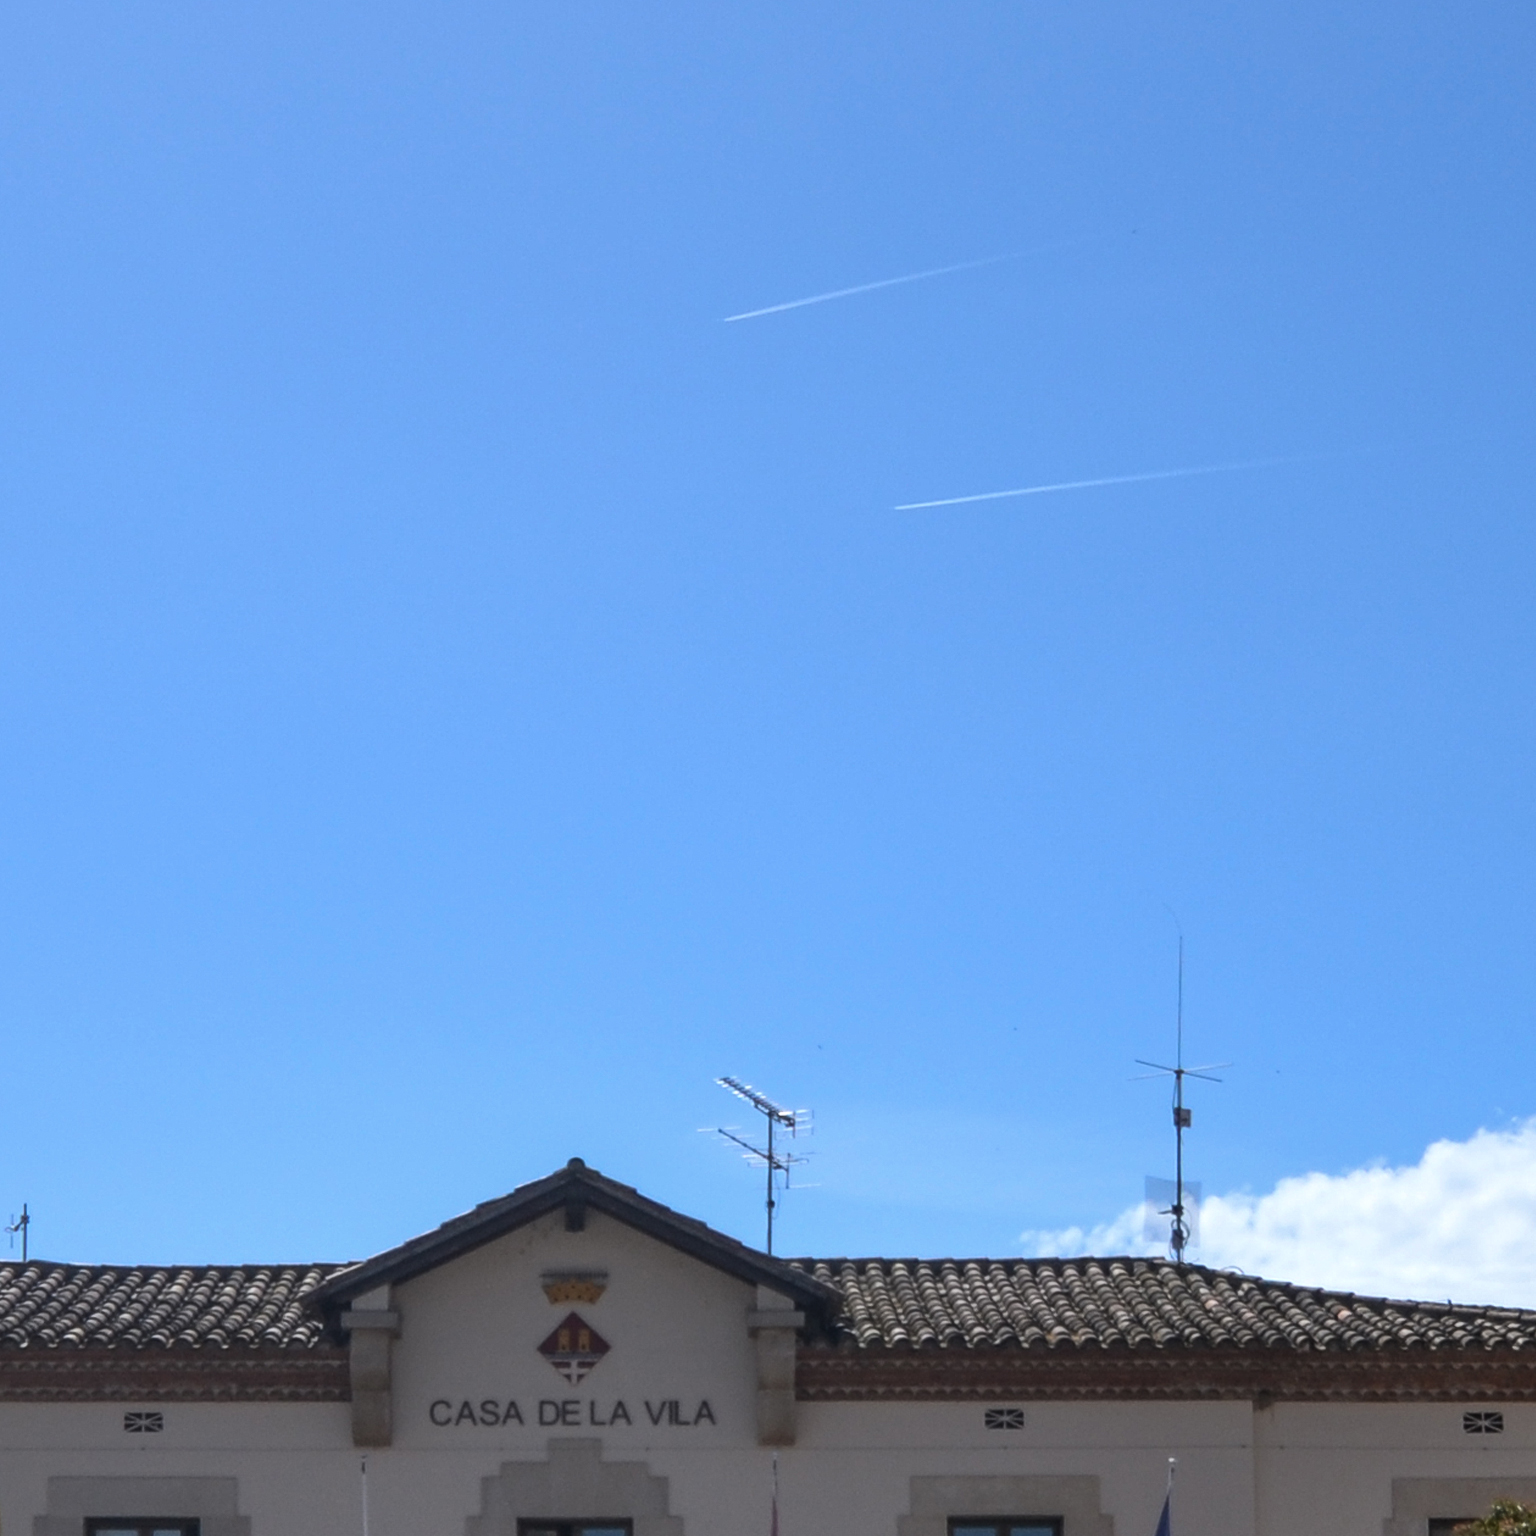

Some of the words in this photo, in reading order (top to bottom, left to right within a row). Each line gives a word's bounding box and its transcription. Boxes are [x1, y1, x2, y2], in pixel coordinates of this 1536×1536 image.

[429, 1400, 524, 1427] CASA
[538, 1400, 581, 1427] DE
[590, 1400, 632, 1427] LA
[645, 1400, 717, 1427] VILA
